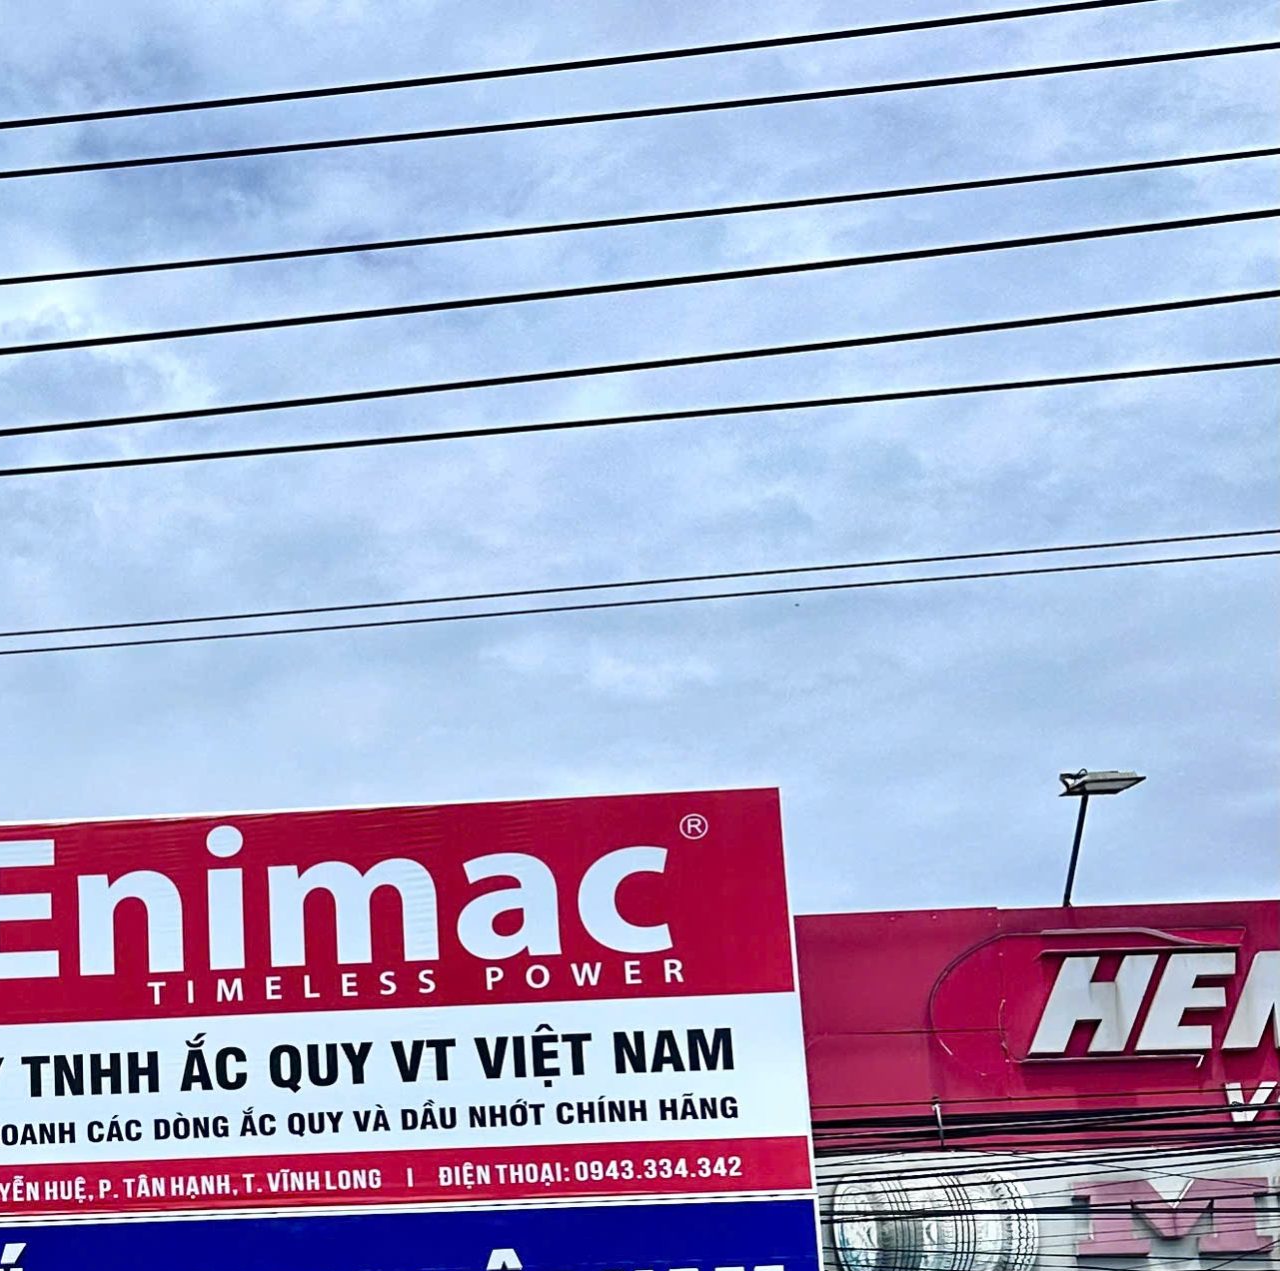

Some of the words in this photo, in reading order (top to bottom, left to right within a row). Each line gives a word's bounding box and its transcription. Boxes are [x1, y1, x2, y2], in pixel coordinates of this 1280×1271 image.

[149, 970, 439, 1005] TIMELESS
[485, 958, 687, 992] POWER
[21, 1051, 159, 1097] TNHH
[180, 1032, 247, 1091] ẮC
[269, 1041, 373, 1093] QUY
[390, 1038, 456, 1083] VT
[474, 1023, 592, 1088] VIỆT
[612, 1027, 735, 1073] NAM
[86, 1115, 142, 1142] CÁC
[154, 1112, 229, 1140] DÒNG
[239, 1106, 276, 1137] ẮC
[287, 1110, 344, 1138] QUY
[353, 1104, 390, 1132] VÀ
[401, 1100, 458, 1130] DẦU
[468, 1100, 546, 1129] NHỚT
[556, 1095, 647, 1125] CHÍNH
[659, 1092, 739, 1121] HÃNG
[44, 1175, 95, 1205] HUỆ,
[99, 1178, 119, 1199] P.
[122, 1172, 166, 1198] TÂN
[171, 1174, 239, 1200] HẠNH,
[243, 1173, 262, 1194] T.
[267, 1165, 320, 1193] VĨNH
[325, 1168, 382, 1191] LONG
[438, 1161, 491, 1191] ĐIỆN
[495, 1158, 570, 1189] THOẠI:
[575, 1155, 743, 1182] 0943.334.342
